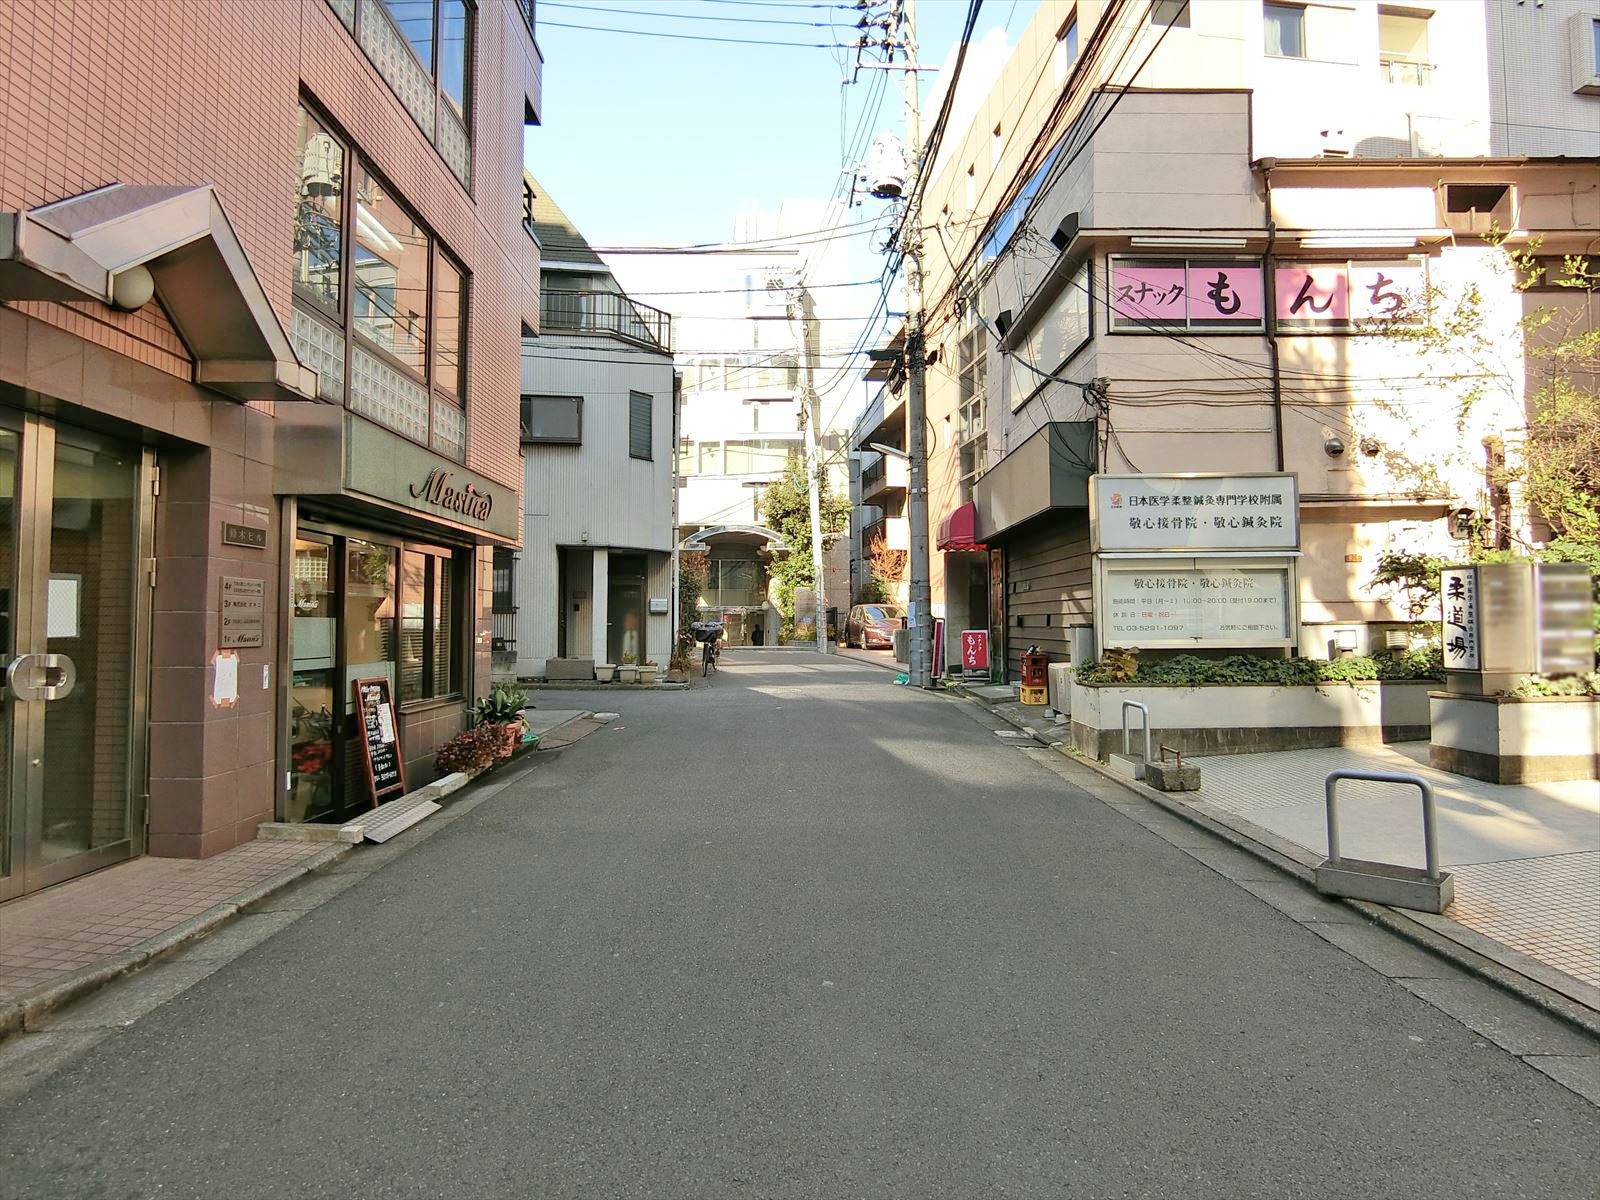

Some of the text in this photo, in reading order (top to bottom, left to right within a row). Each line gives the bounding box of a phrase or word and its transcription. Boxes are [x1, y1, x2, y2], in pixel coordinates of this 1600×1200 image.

[1116, 271, 1404, 315] スナック もんち
[1129, 494, 1282, 507] 日本医学柔整鍼灸専門学校附属
[1129, 516, 1283, 529] 敬心接骨院・敬心鍼灸院
[1446, 576, 1468, 661] 柔道場
[967, 634, 977, 665] もんち
